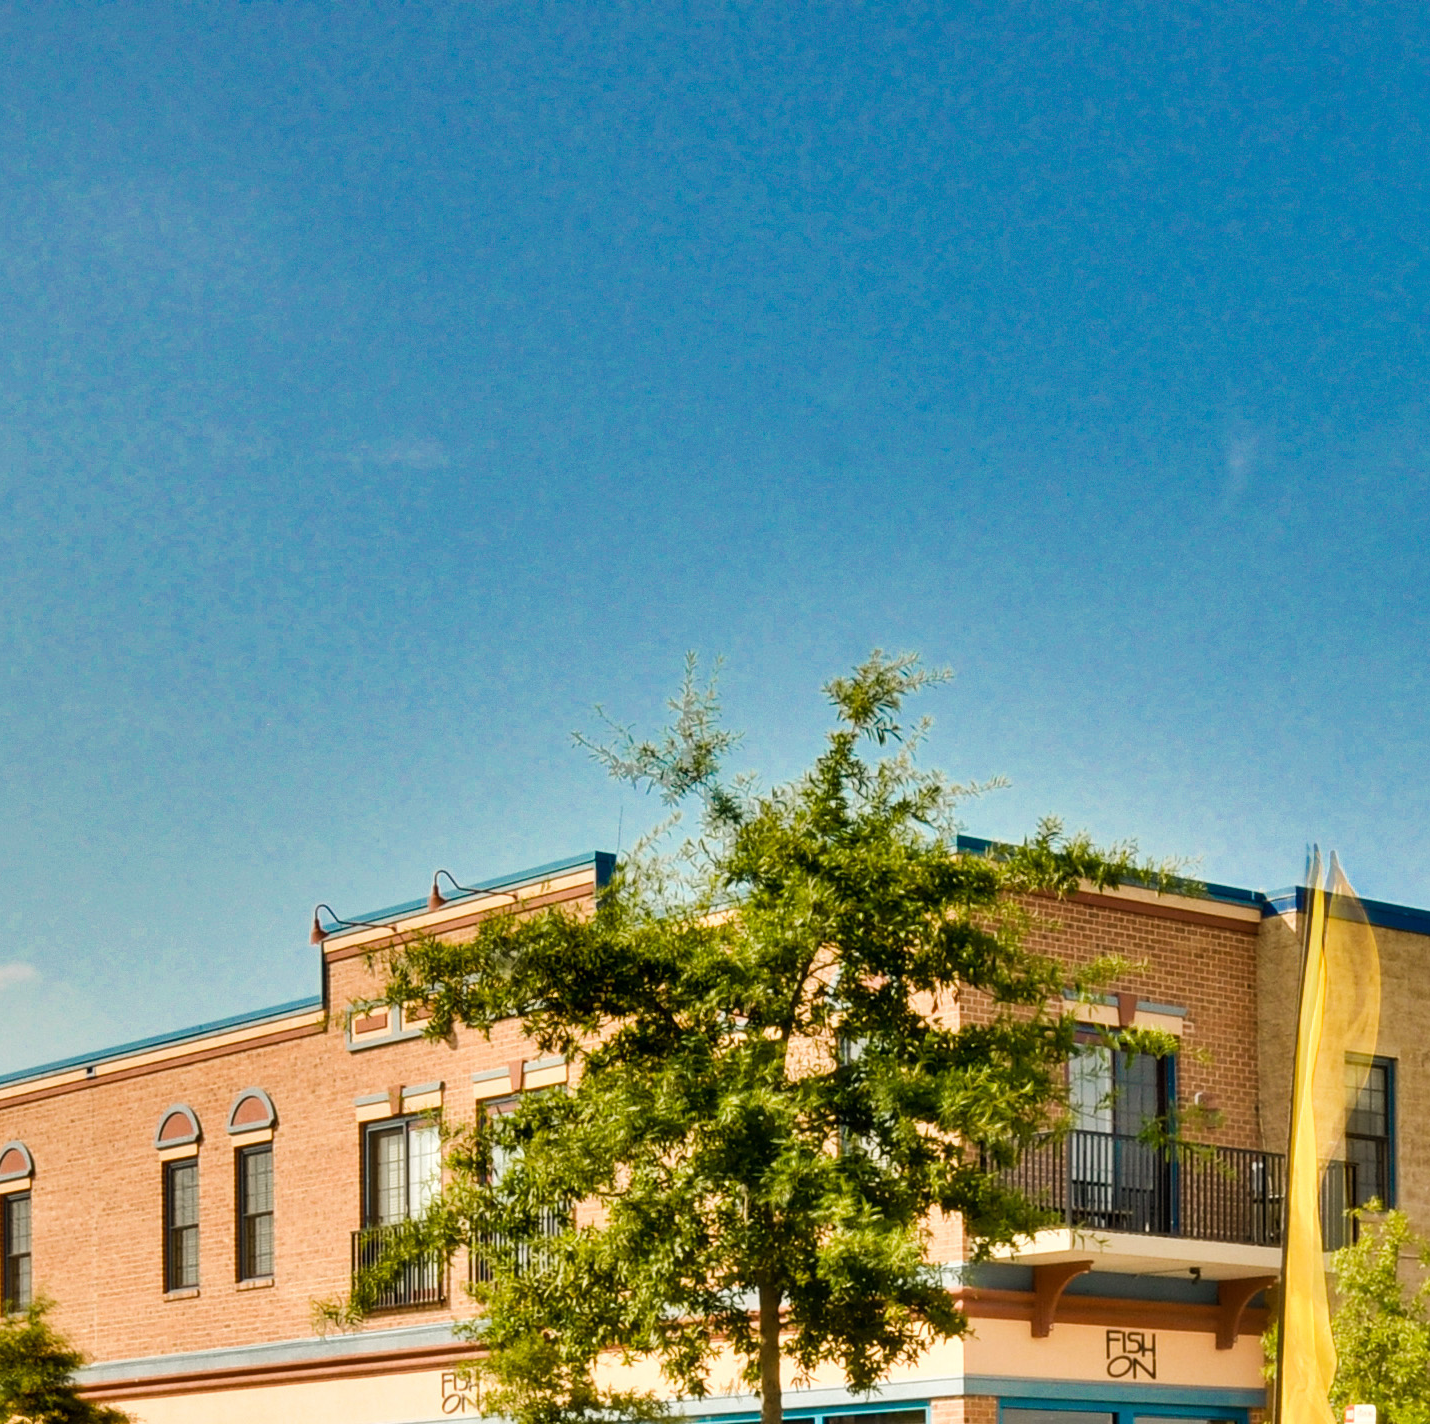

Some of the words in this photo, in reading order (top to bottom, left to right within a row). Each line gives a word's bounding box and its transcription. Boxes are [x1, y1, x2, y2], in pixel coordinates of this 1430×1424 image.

[1106, 1329, 1156, 1359] FISH
[1107, 1355, 1156, 1379] ON
[441, 1393, 480, 1414] ON
